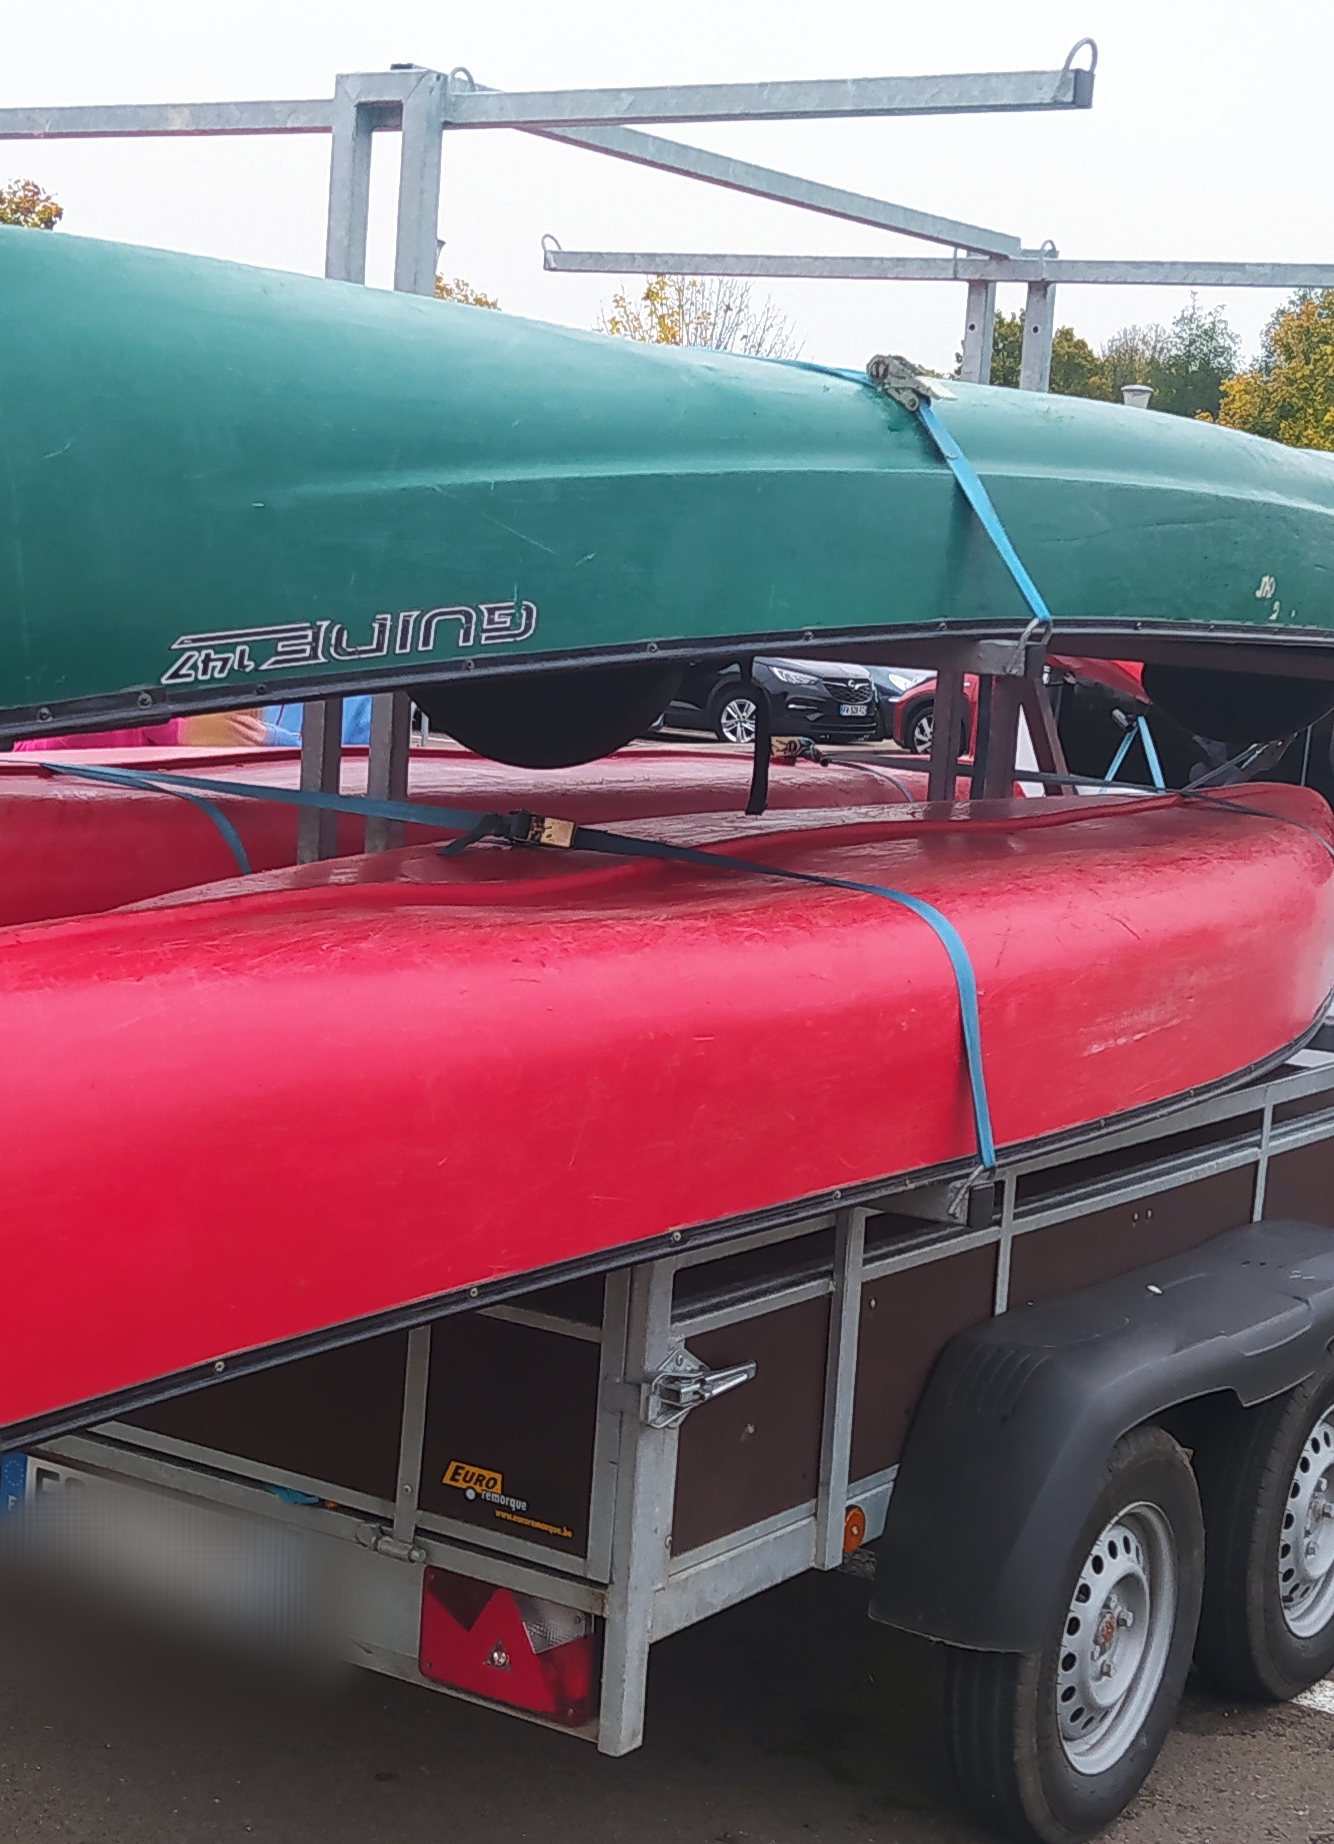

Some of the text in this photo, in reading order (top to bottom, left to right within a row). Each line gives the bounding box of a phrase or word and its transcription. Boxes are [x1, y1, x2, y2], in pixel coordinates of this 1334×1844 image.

[160, 645, 255, 686] 147
[449, 1464, 498, 1490] EURO
[7, 1493, 18, 1512] F
[481, 1490, 527, 1512] remorque
